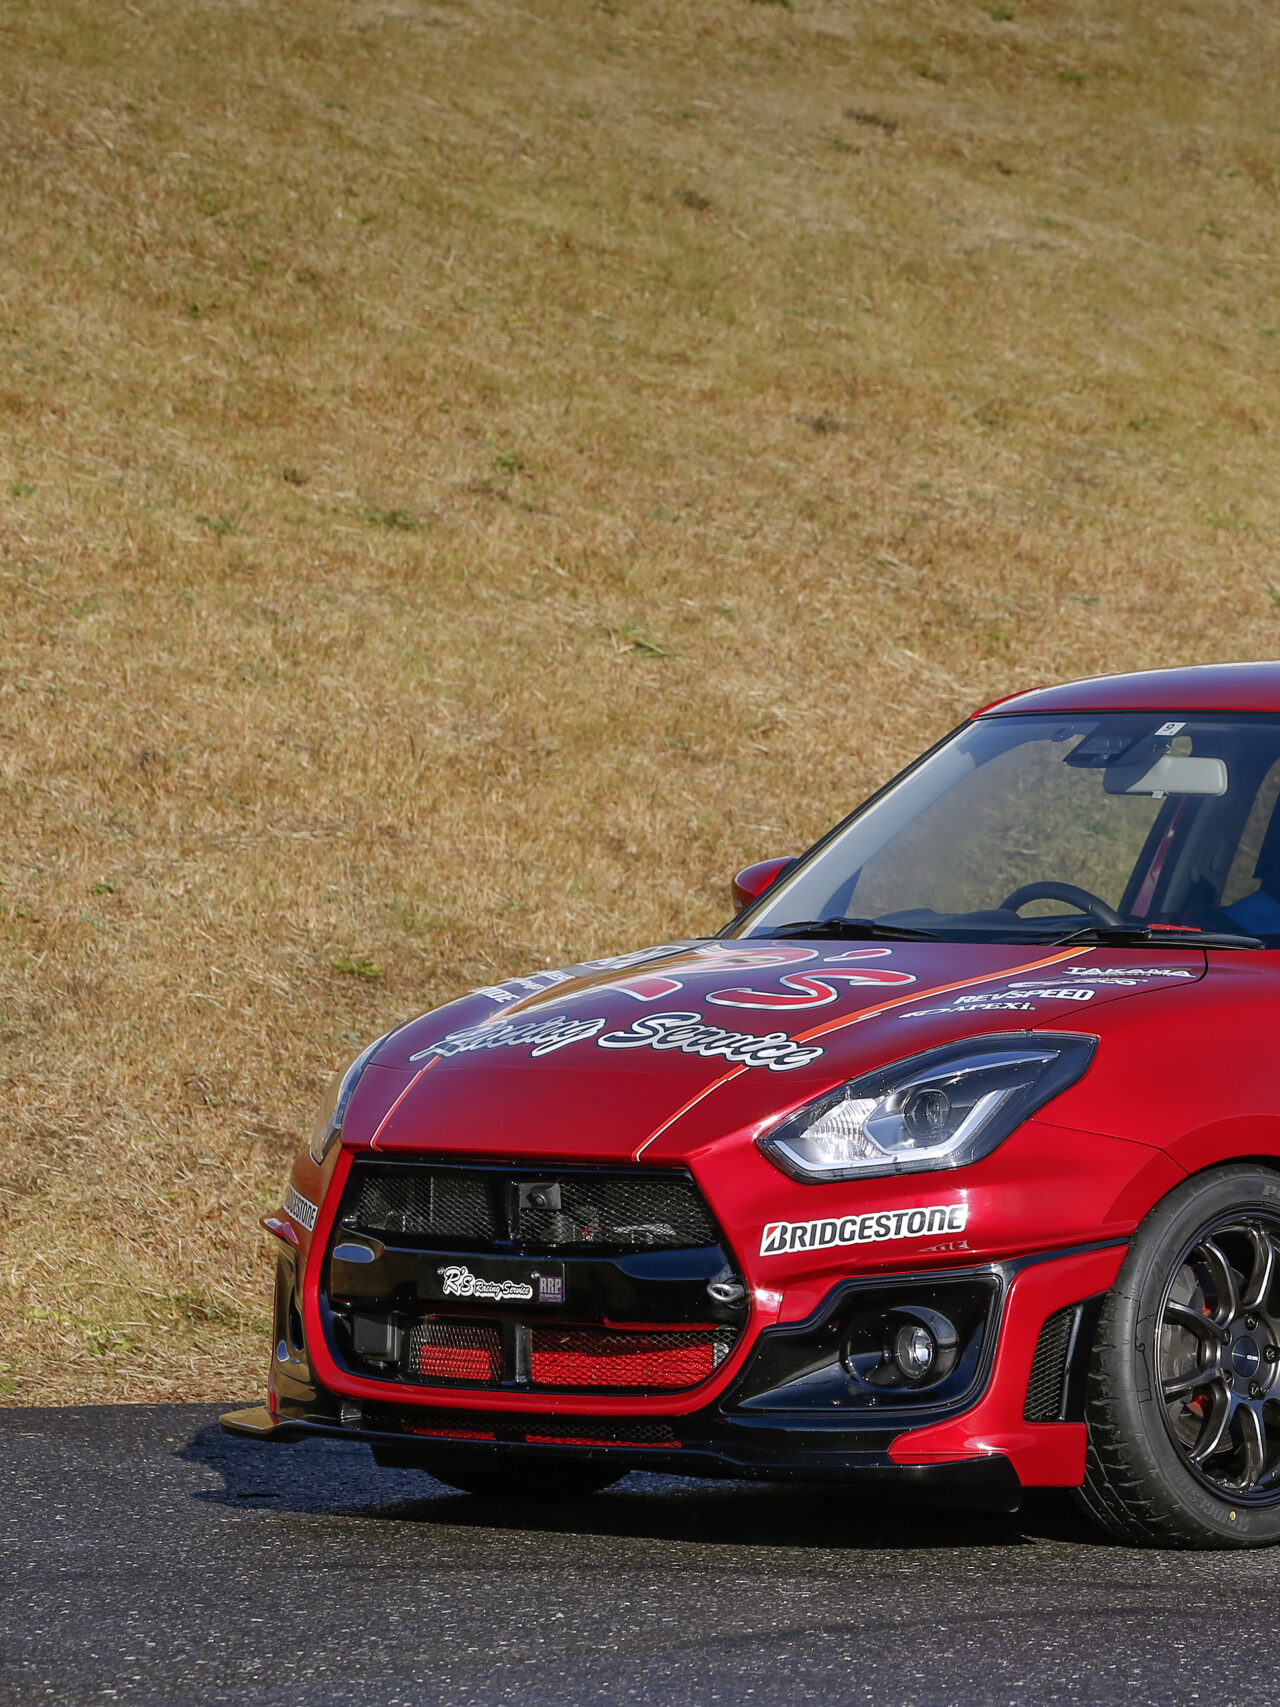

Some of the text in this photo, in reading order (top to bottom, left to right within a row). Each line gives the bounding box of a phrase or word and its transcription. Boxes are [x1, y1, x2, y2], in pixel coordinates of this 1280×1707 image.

[952, 988, 1096, 1005] REVSPEED
[597, 1012, 826, 1072] Service
[763, 1206, 966, 1254] BRIDGESTONE
[444, 1267, 532, 1297] R's Racing Service
[540, 1278, 561, 1294] RRP
